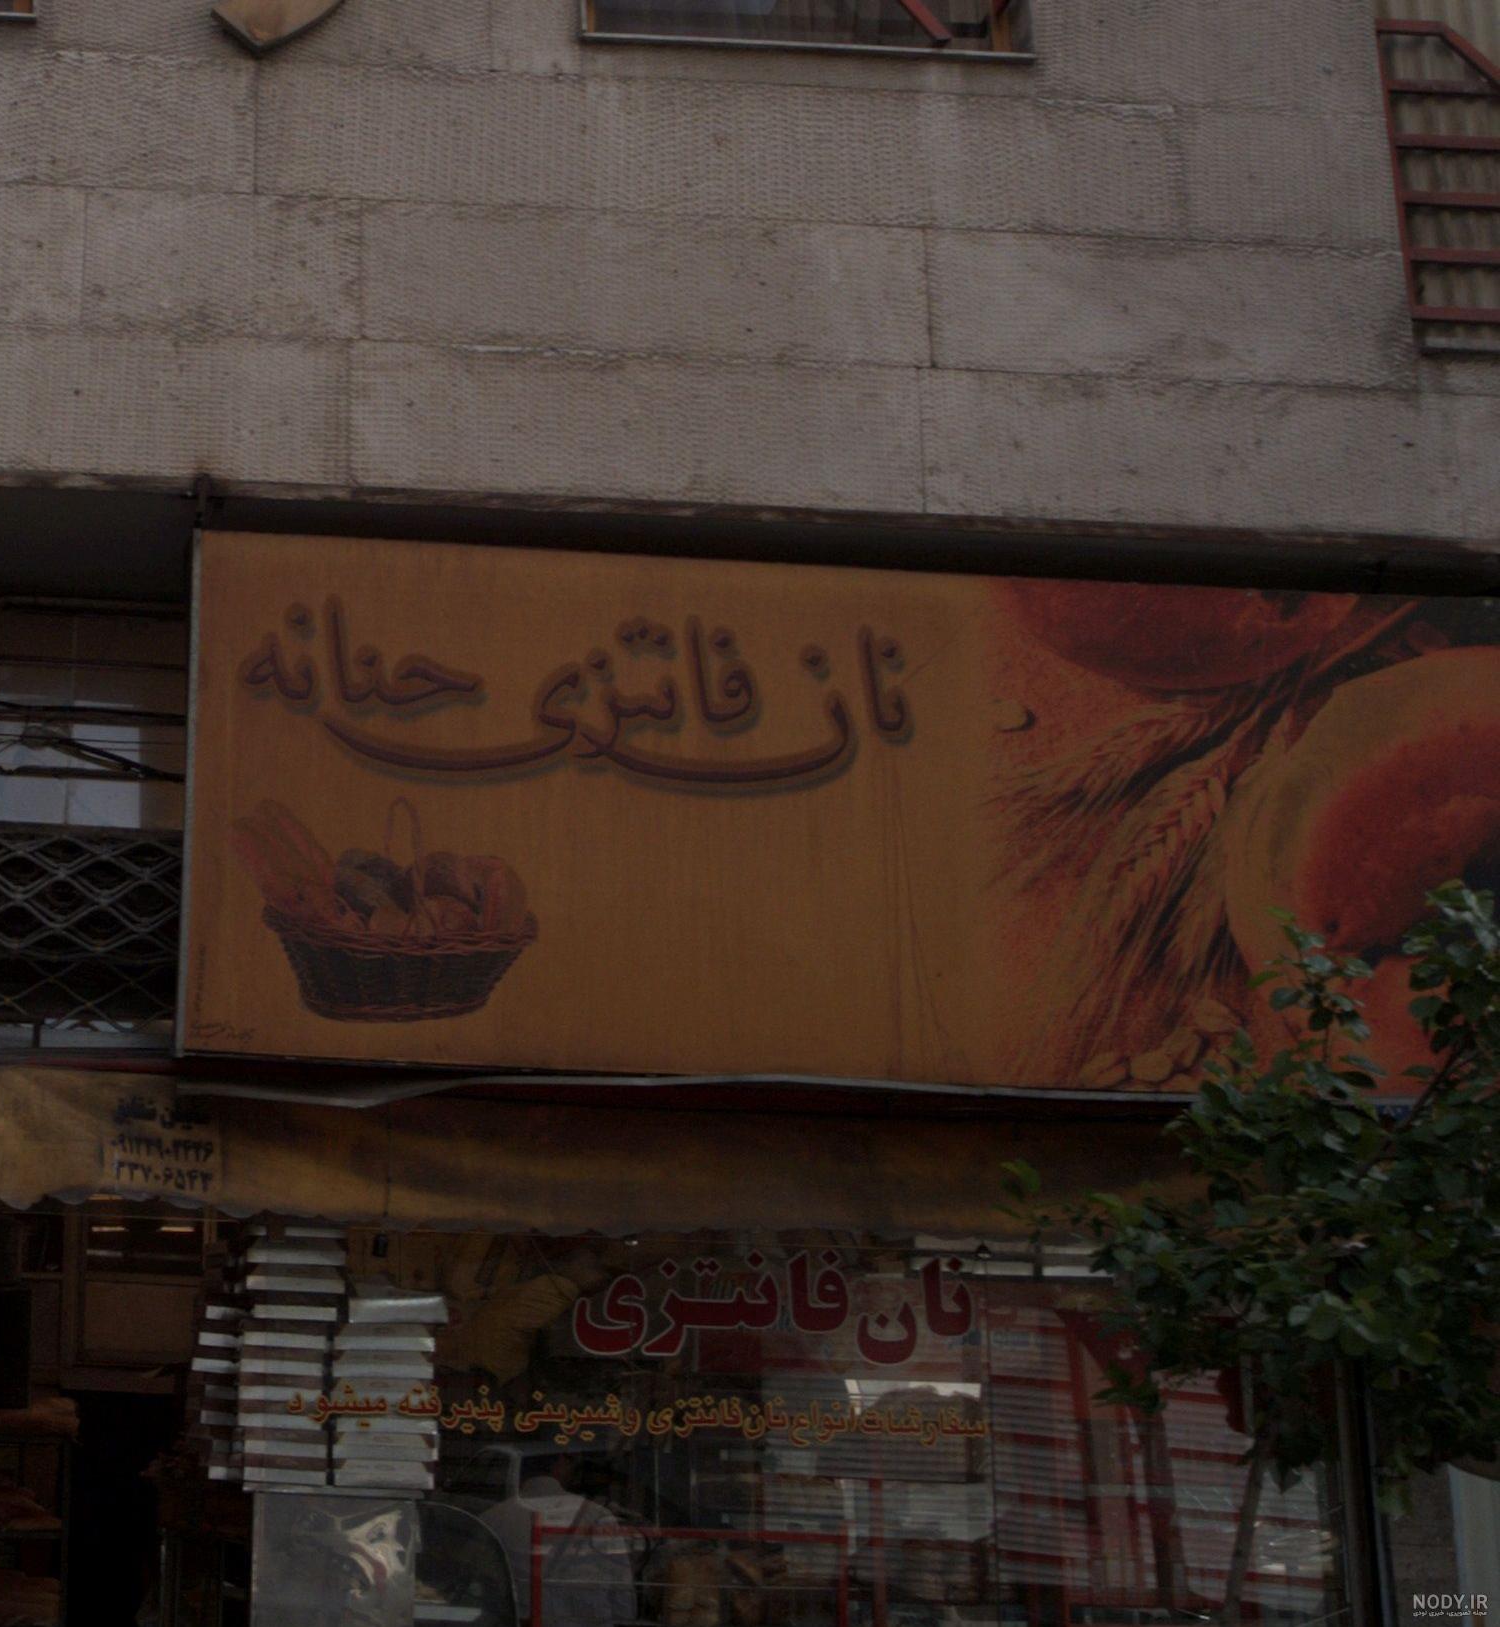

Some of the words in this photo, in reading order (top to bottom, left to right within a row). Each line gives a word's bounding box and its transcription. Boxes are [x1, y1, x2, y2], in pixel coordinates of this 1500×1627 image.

[240, 595, 482, 709] حنانه
[580, 622, 908, 785] نان
[573, 1249, 850, 1356] فانتزی
[857, 1256, 975, 1366] نان
[398, 1384, 506, 1434] پذیرفته
[646, 1394, 743, 1439] فانتزی
[743, 1395, 791, 1440] نان
[789, 1394, 860, 1447] انواع
[860, 1404, 990, 1447] سفارشات
